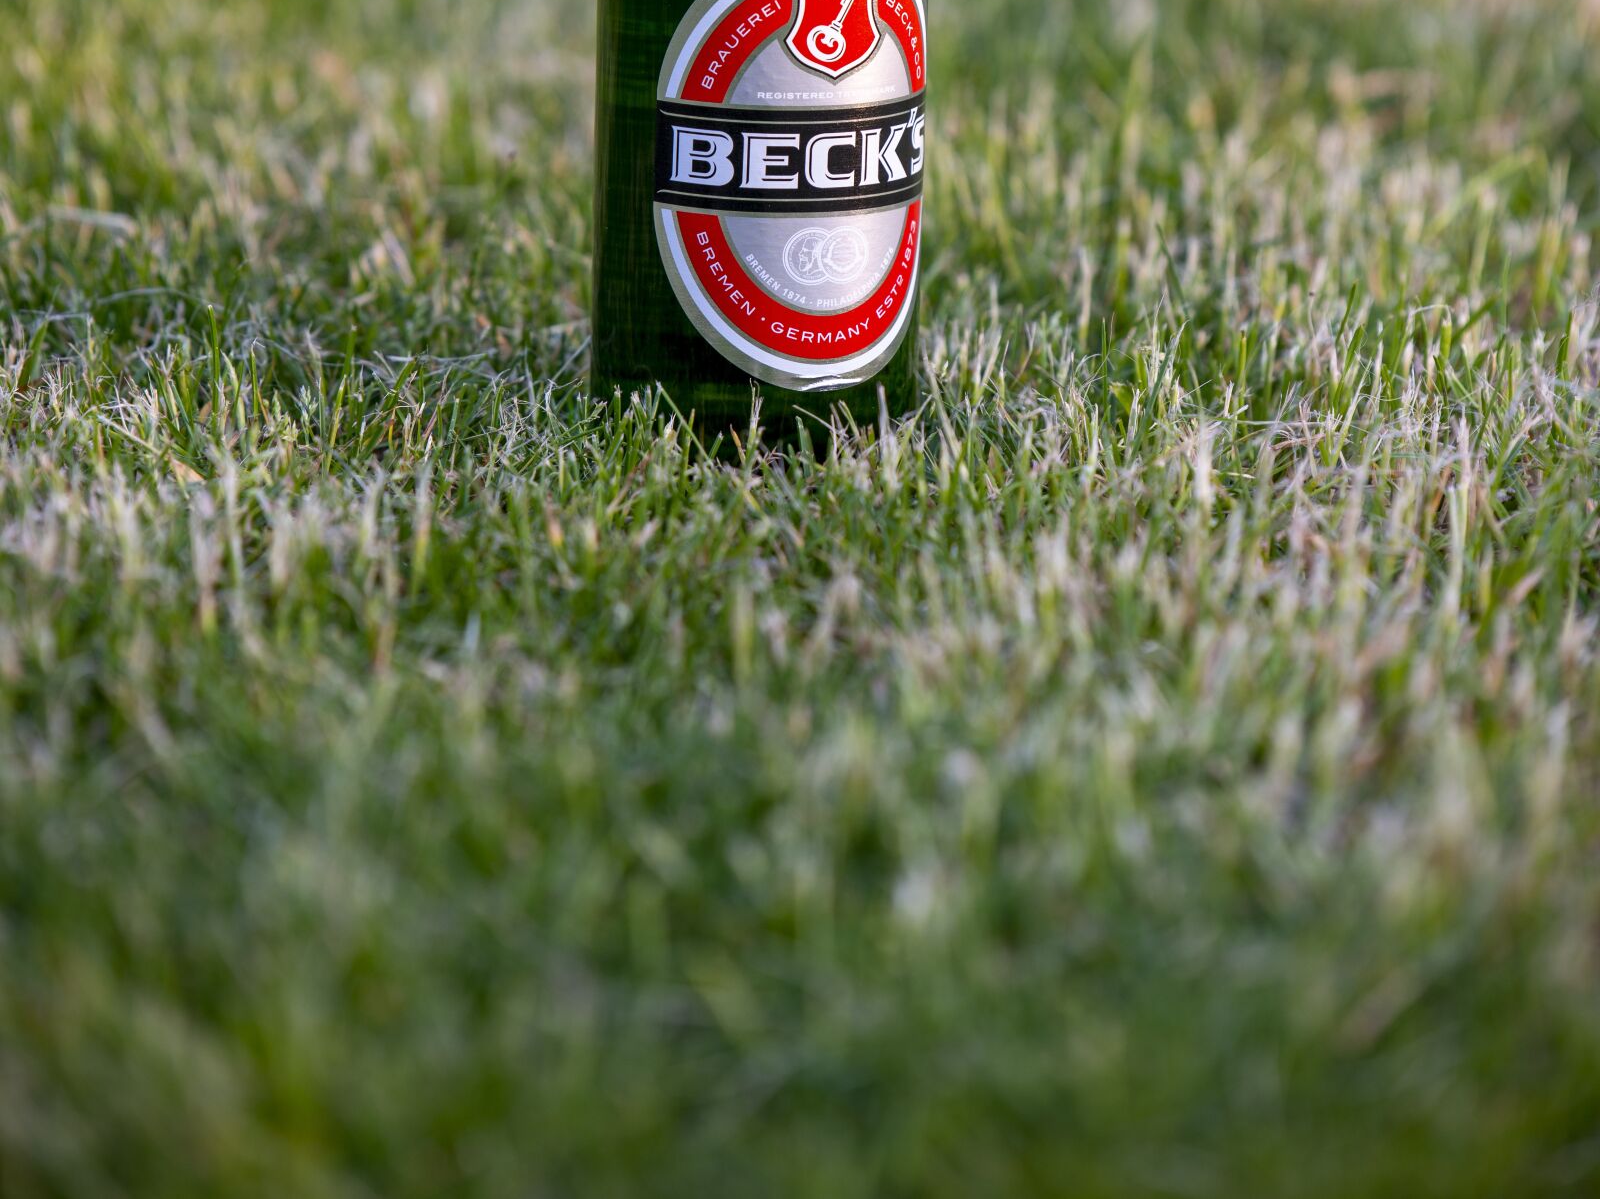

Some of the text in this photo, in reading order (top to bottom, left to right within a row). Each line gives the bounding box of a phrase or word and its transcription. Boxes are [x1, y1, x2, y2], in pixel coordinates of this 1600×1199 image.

[701, 0, 782, 90] BRAUEREI
[757, 91, 835, 100] REGISTERED
[669, 106, 926, 189] BECK'S
[696, 231, 756, 316] BREMEN
[770, 319, 870, 344] GERMANY
[901, 220, 917, 270] 1873
[745, 253, 781, 291] BREMEN
[782, 288, 807, 304] 1874
